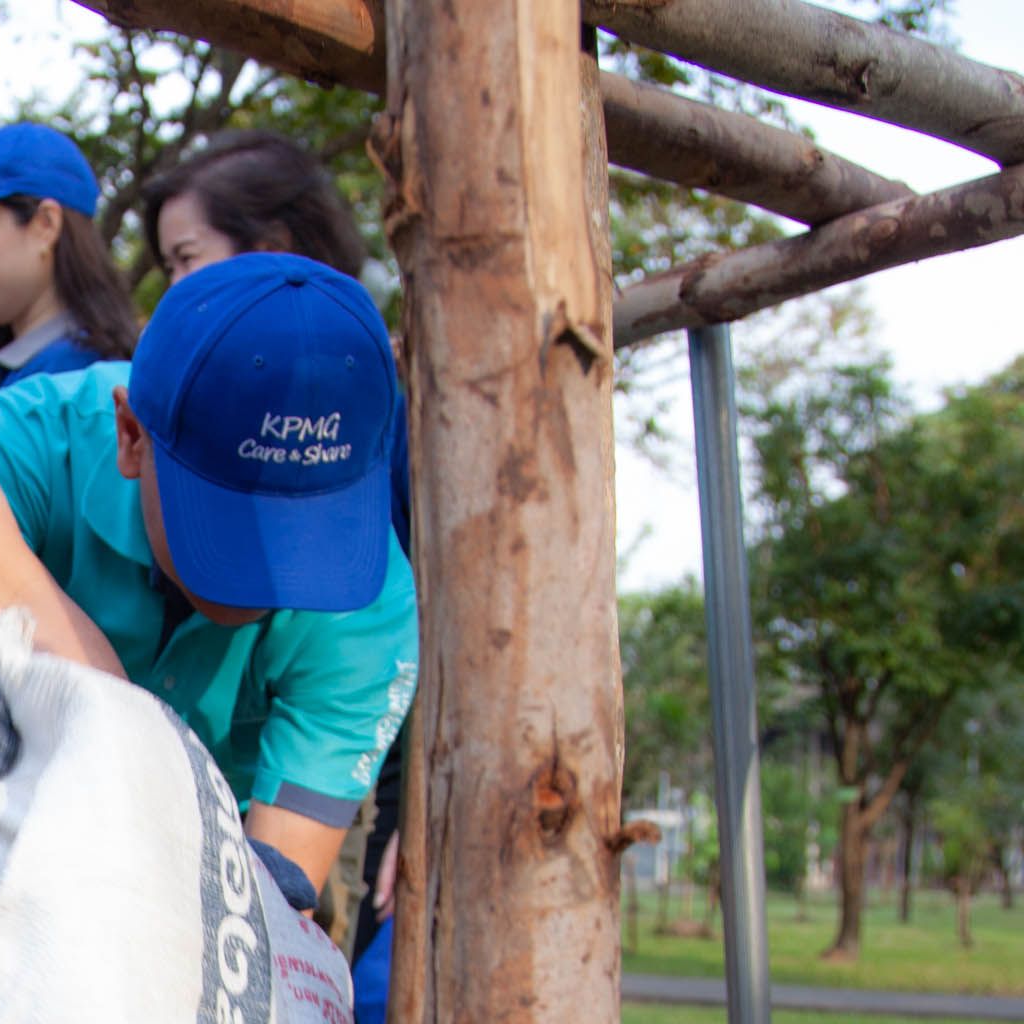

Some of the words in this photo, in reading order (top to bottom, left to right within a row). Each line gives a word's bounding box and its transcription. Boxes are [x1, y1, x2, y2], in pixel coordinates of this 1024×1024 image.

[260, 412, 341, 442] KPMG
[238, 438, 287, 463] Care
[289, 448, 302, 462] &
[302, 443, 352, 466] Share
